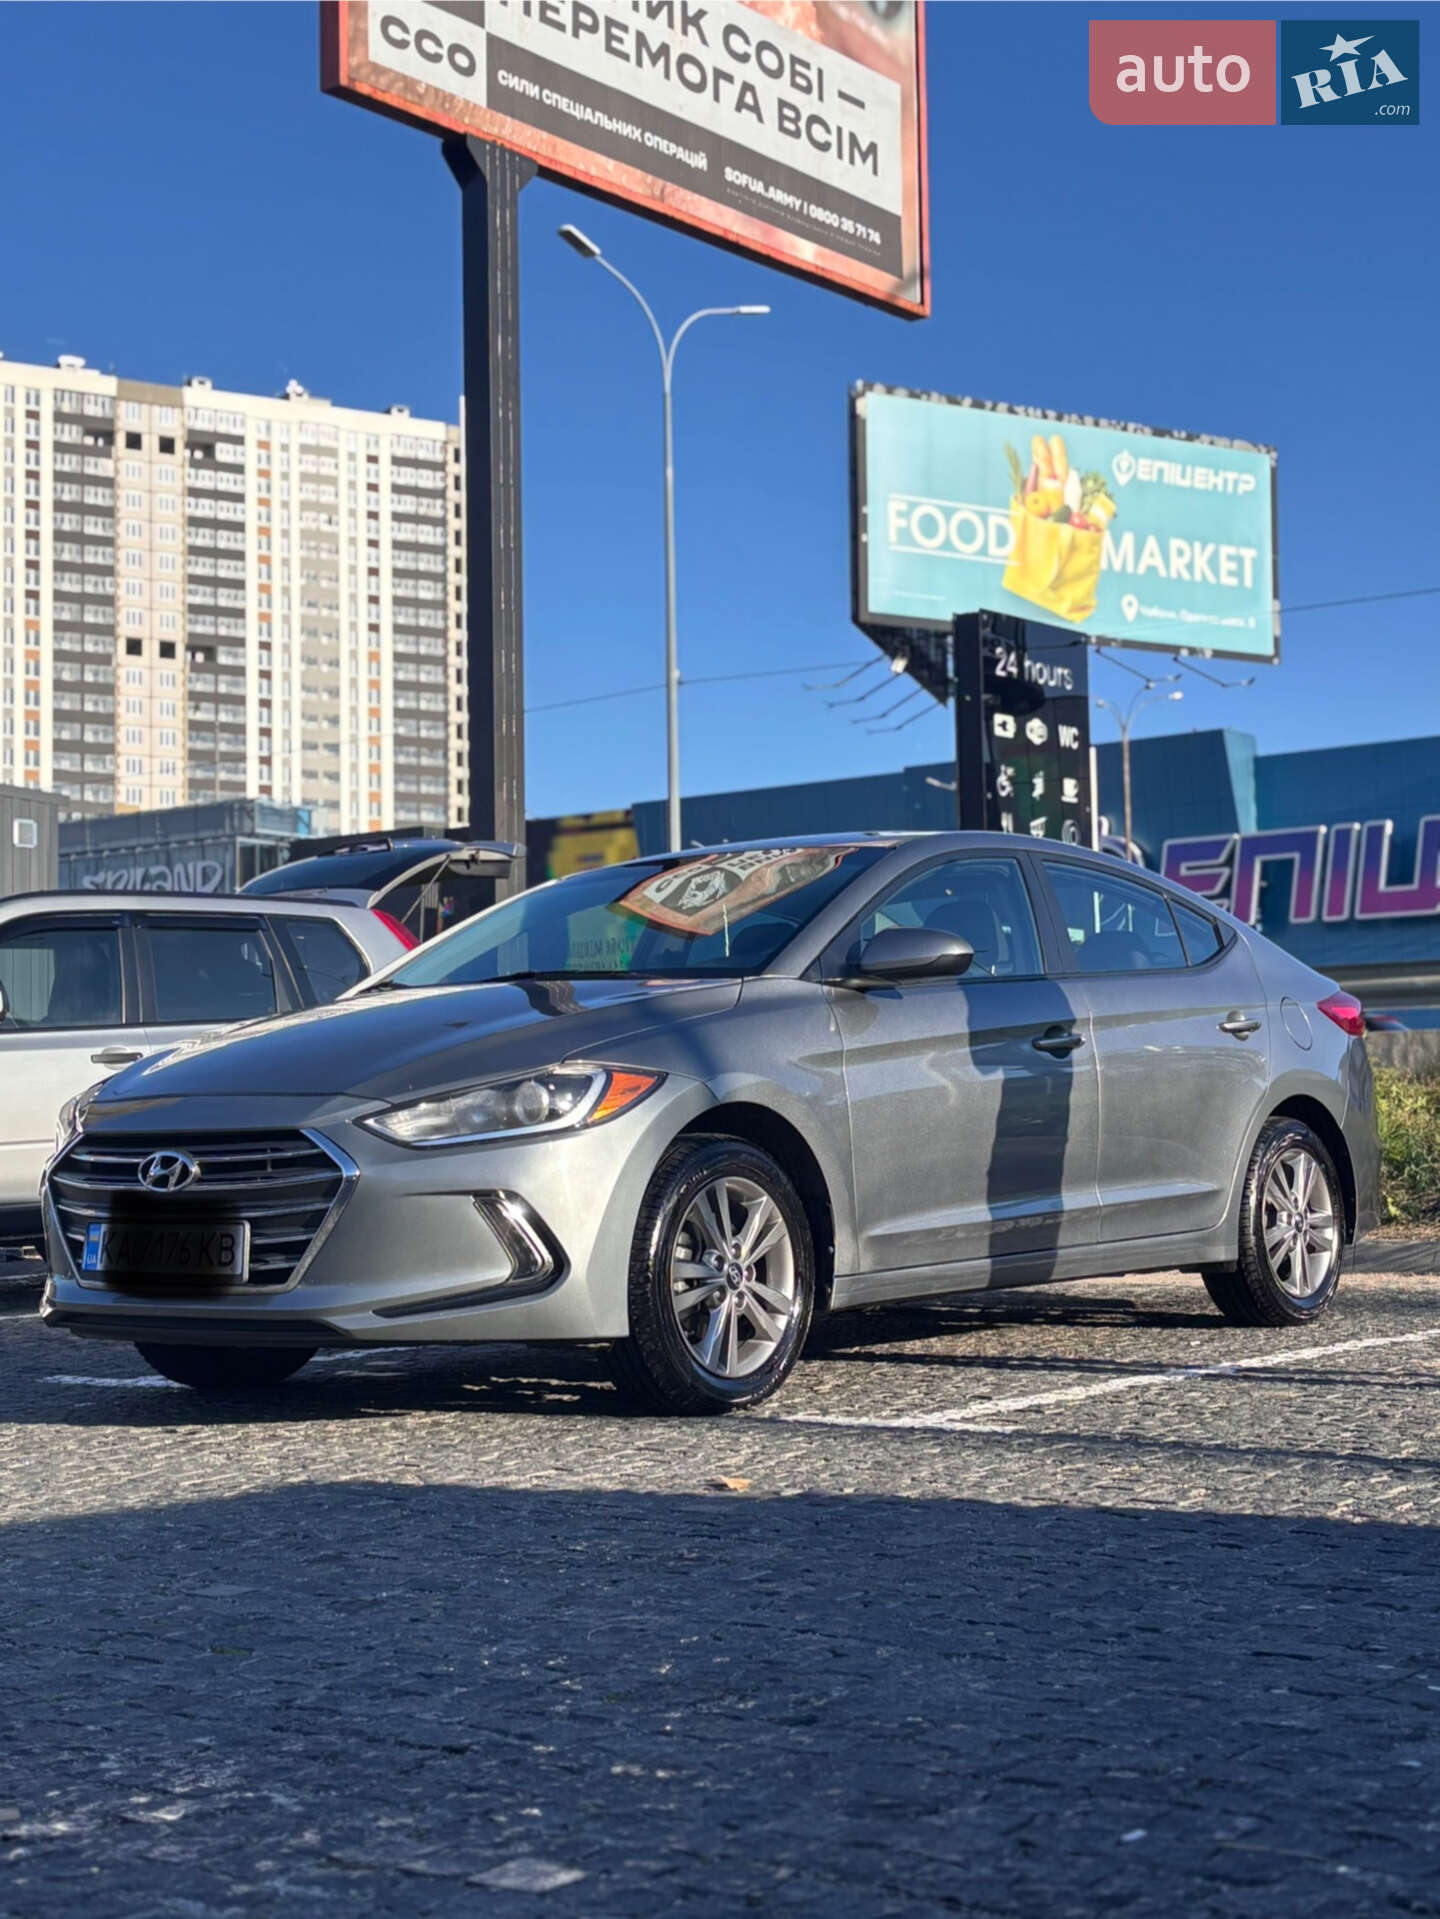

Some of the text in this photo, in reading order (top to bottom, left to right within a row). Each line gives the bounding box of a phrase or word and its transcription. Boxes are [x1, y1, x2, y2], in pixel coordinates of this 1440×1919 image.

[380, 15, 477, 78] ССО
[722, 24, 824, 103] СОБІ
[497, 69, 708, 172] СИЛИ СПЕЦІАЛЬНИХ ОПЕРАЦІЙ
[777, 97, 878, 177] ВСІМ
[723, 166, 802, 212] SOFUA.ARMY
[808, 204, 840, 228] 0800
[1136, 457, 1257, 495] ЕПІЦЕНТР
[887, 501, 1258, 589] FOOD MARKET
[994, 646, 1074, 690] 24 hours
[1057, 723, 1080, 750] WC
